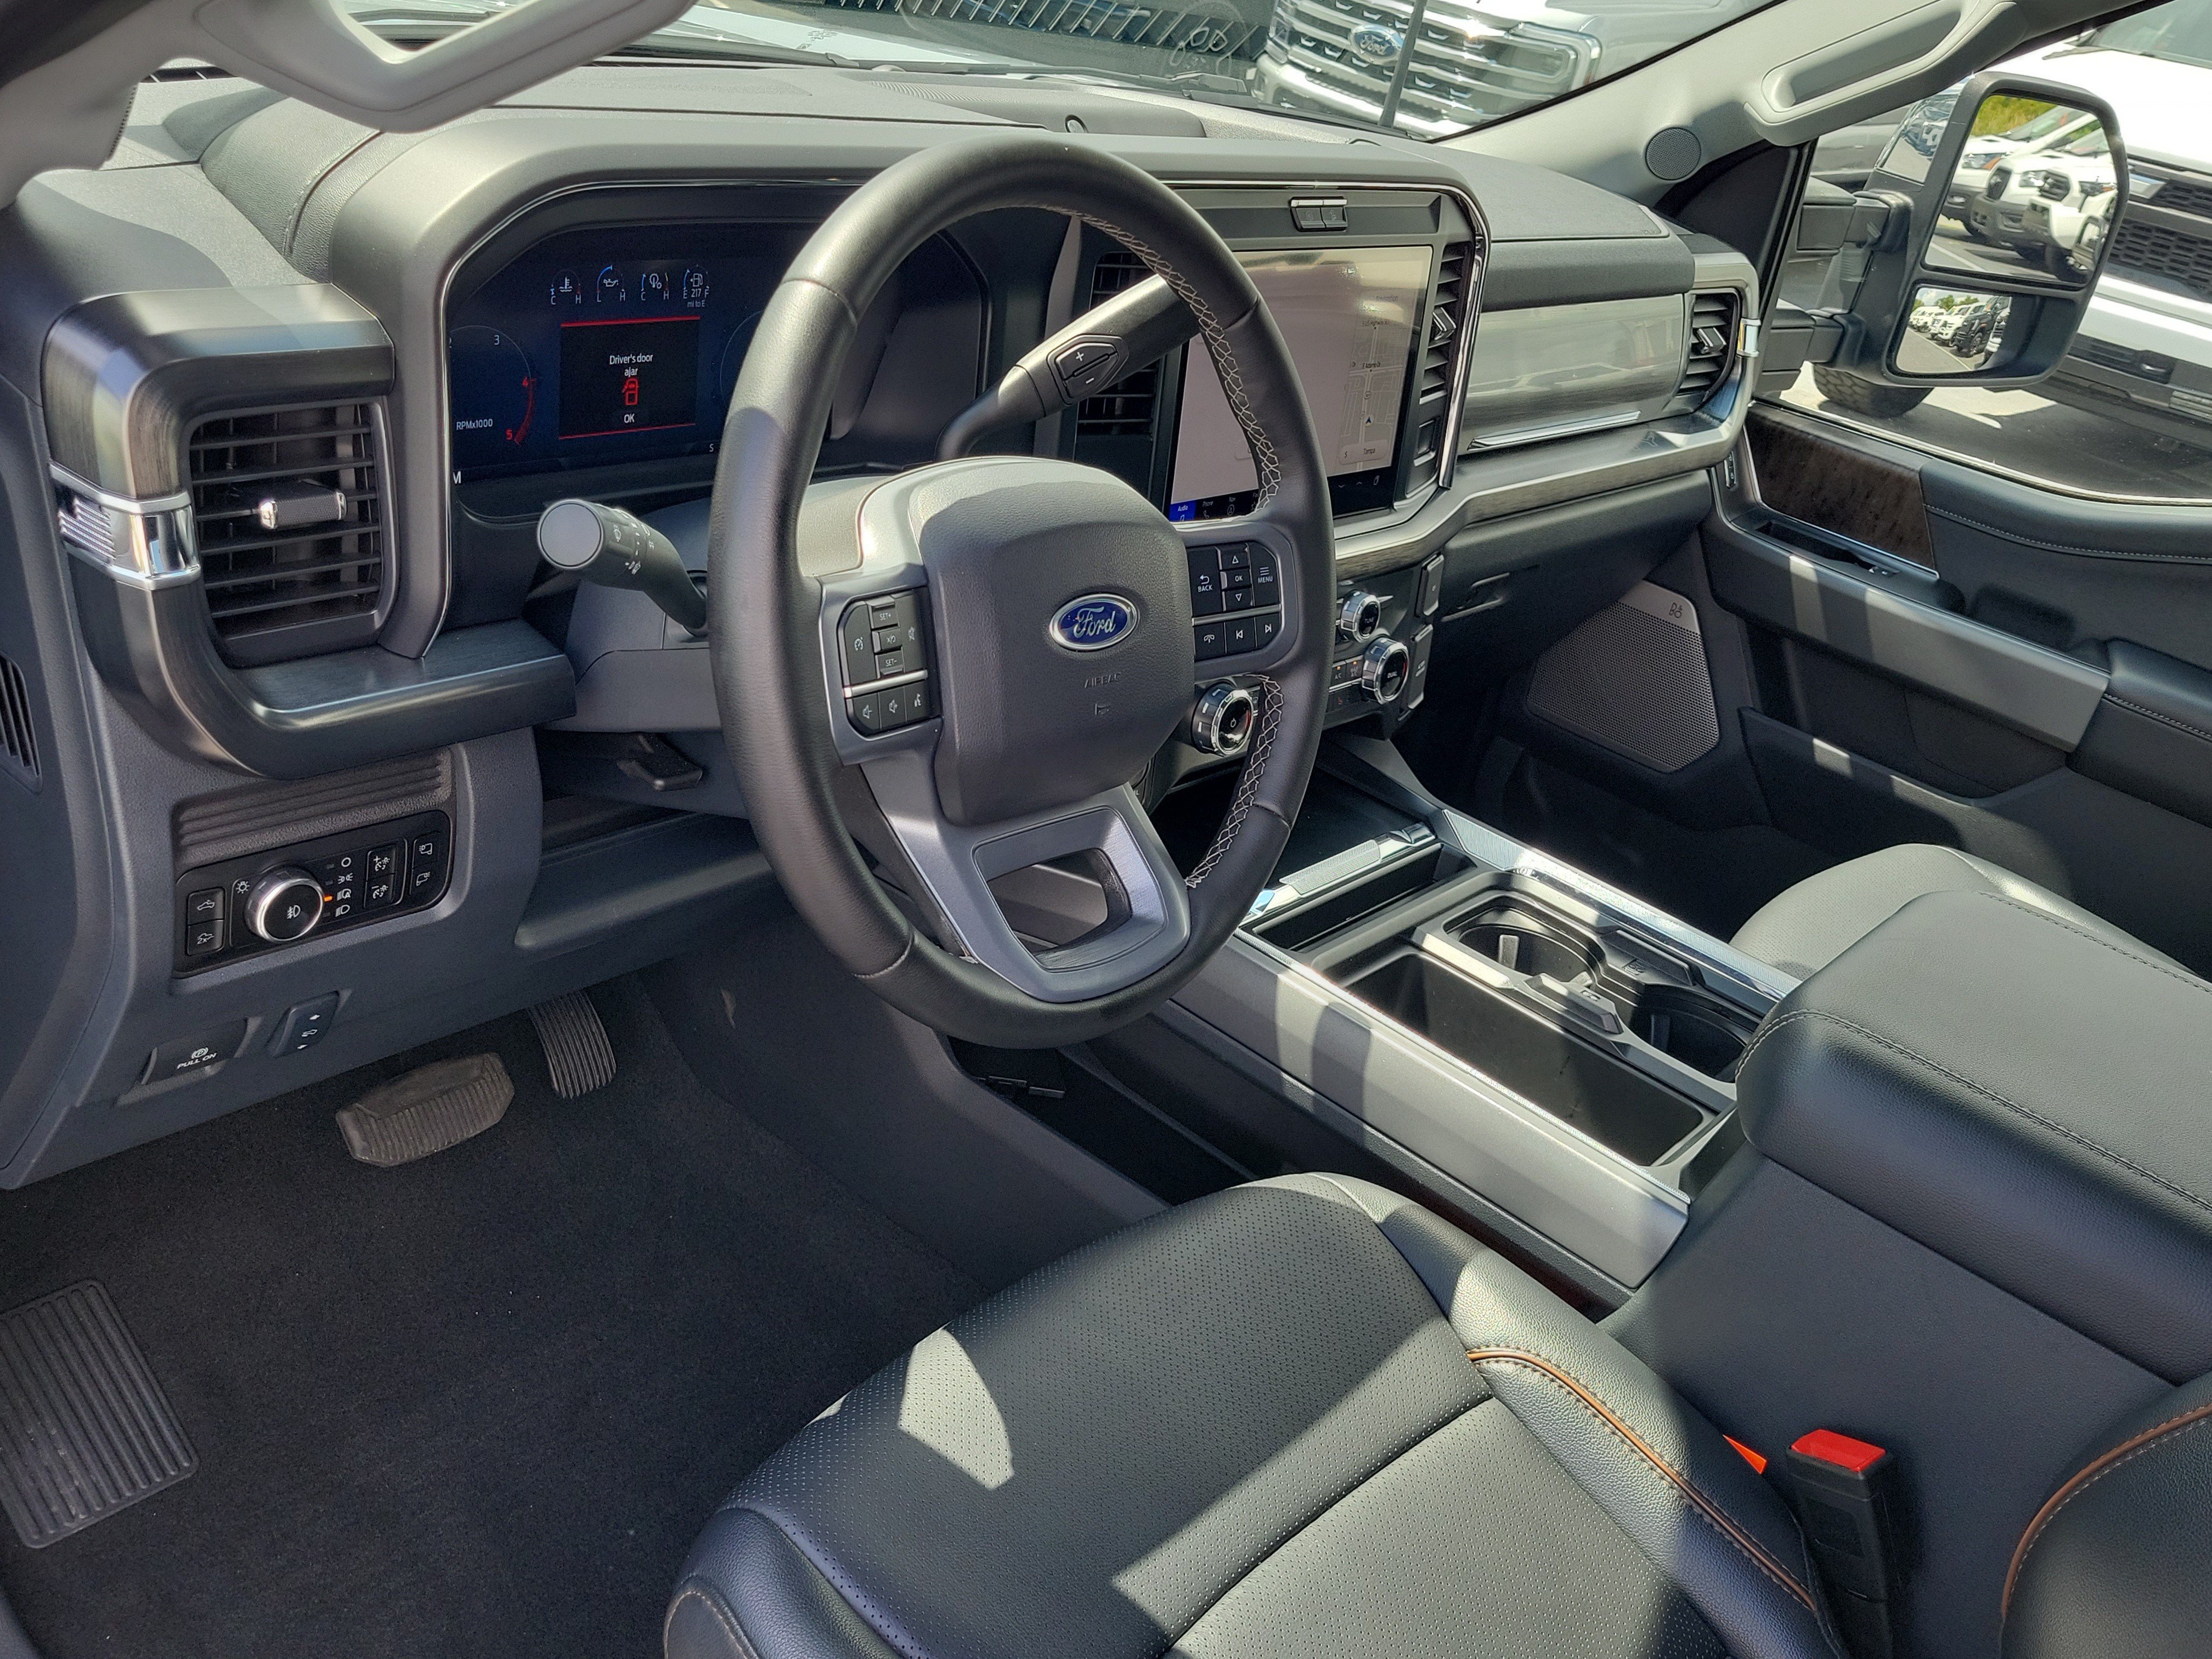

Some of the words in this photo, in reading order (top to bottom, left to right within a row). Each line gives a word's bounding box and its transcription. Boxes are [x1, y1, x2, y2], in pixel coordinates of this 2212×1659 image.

[597, 292, 602, 302] L
[620, 291, 626, 301] H
[641, 291, 646, 301] C
[663, 290, 669, 300] H
[683, 290, 688, 299] E
[691, 289, 701, 298] 217
[704, 289, 710, 298] F
[550, 296, 556, 305] C
[575, 294, 582, 304] H
[494, 335, 500, 345] 3
[610, 354, 636, 365] Driver's
[637, 353, 653, 363] door
[624, 366, 639, 377] ajar
[624, 414, 635, 423] OK
[456, 419, 493, 430] RPMx1000
[505, 428, 513, 441] 5
[1073, 606, 1116, 639] Ford
[177, 1059, 201, 1070] PULL
[202, 1053, 217, 1061] ON
